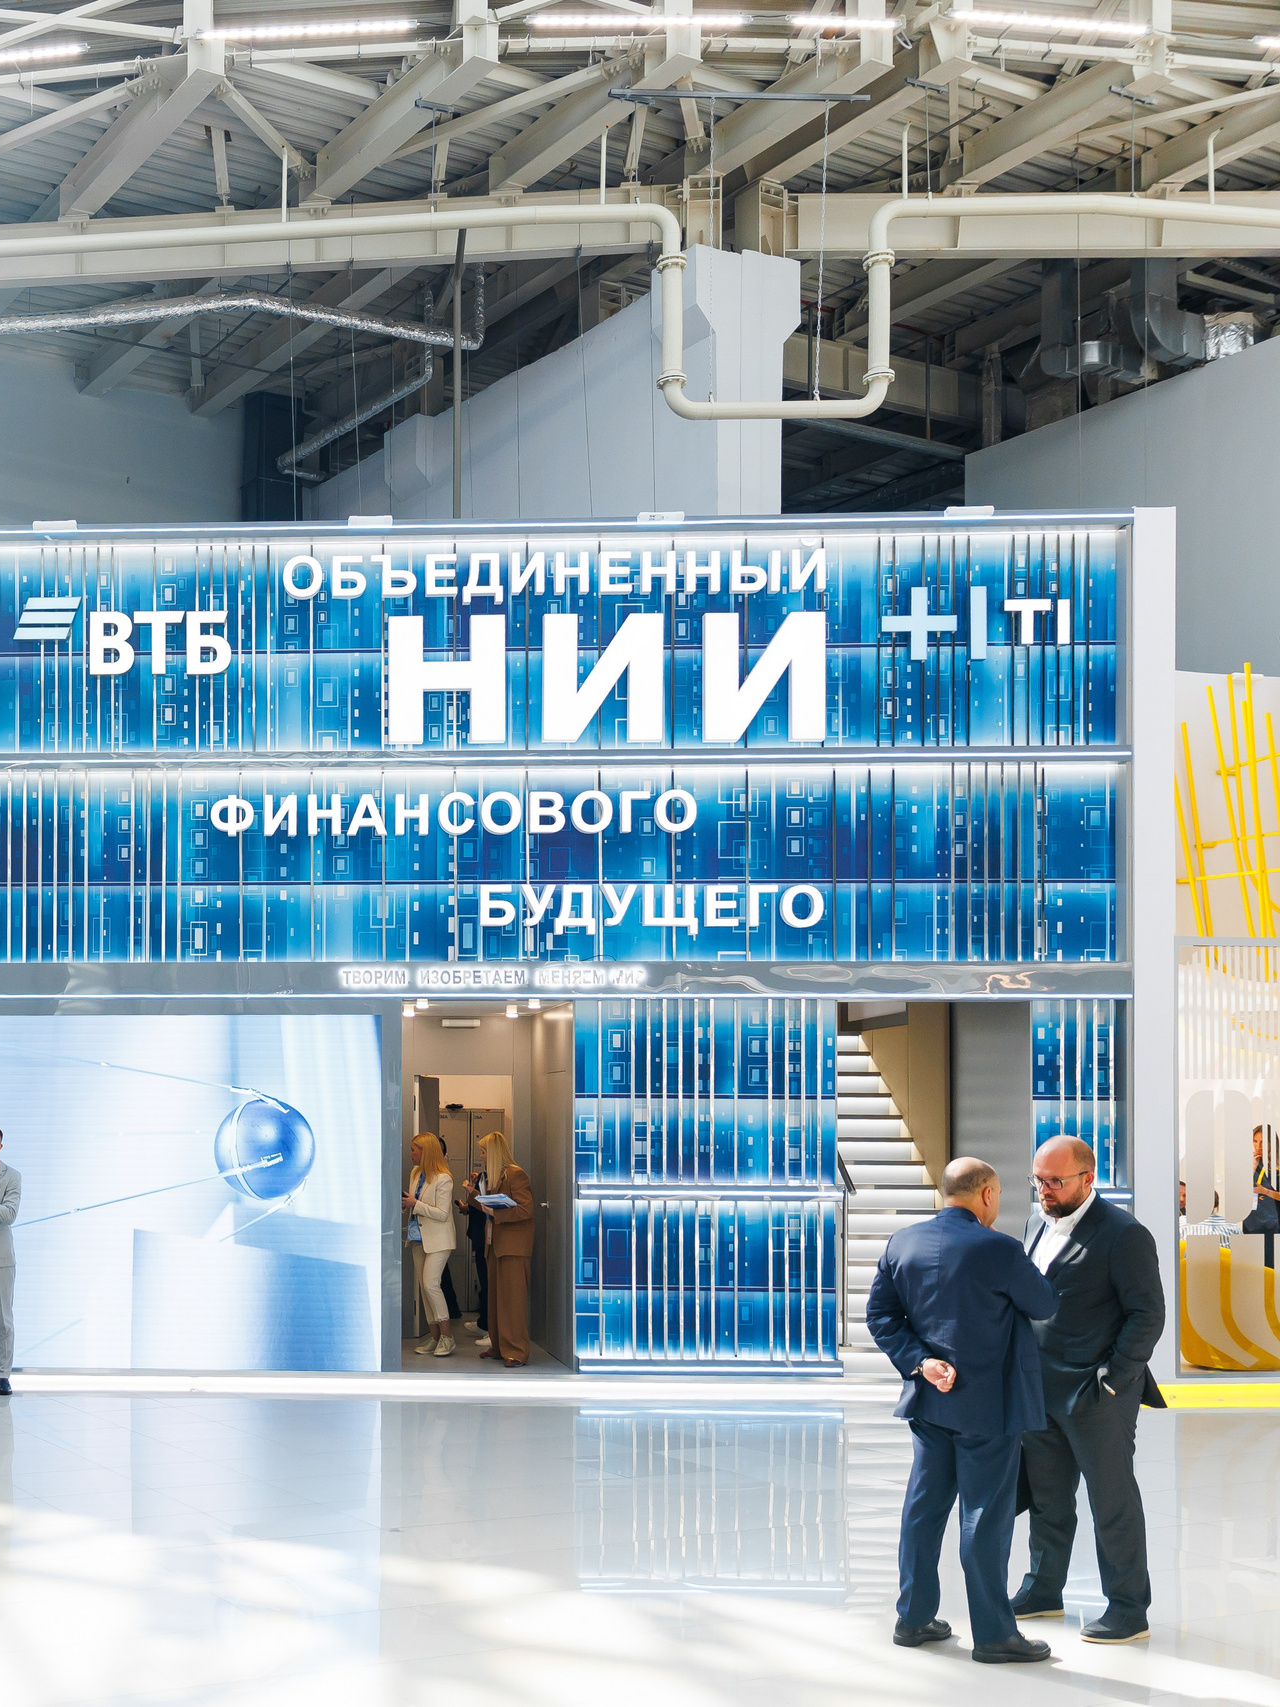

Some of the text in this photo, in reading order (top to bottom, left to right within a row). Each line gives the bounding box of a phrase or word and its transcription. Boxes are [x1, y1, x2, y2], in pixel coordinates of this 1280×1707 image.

[282, 538, 827, 604] ОБЪЕДИНЕННЫЙ
[87, 609, 233, 676] ВТБ
[387, 611, 828, 745] НИИ
[208, 789, 699, 838] ФИНАНСОВОГО
[478, 883, 826, 935] БУДУЩЕГО
[538, 969, 605, 985] МЕНЯЕМ
